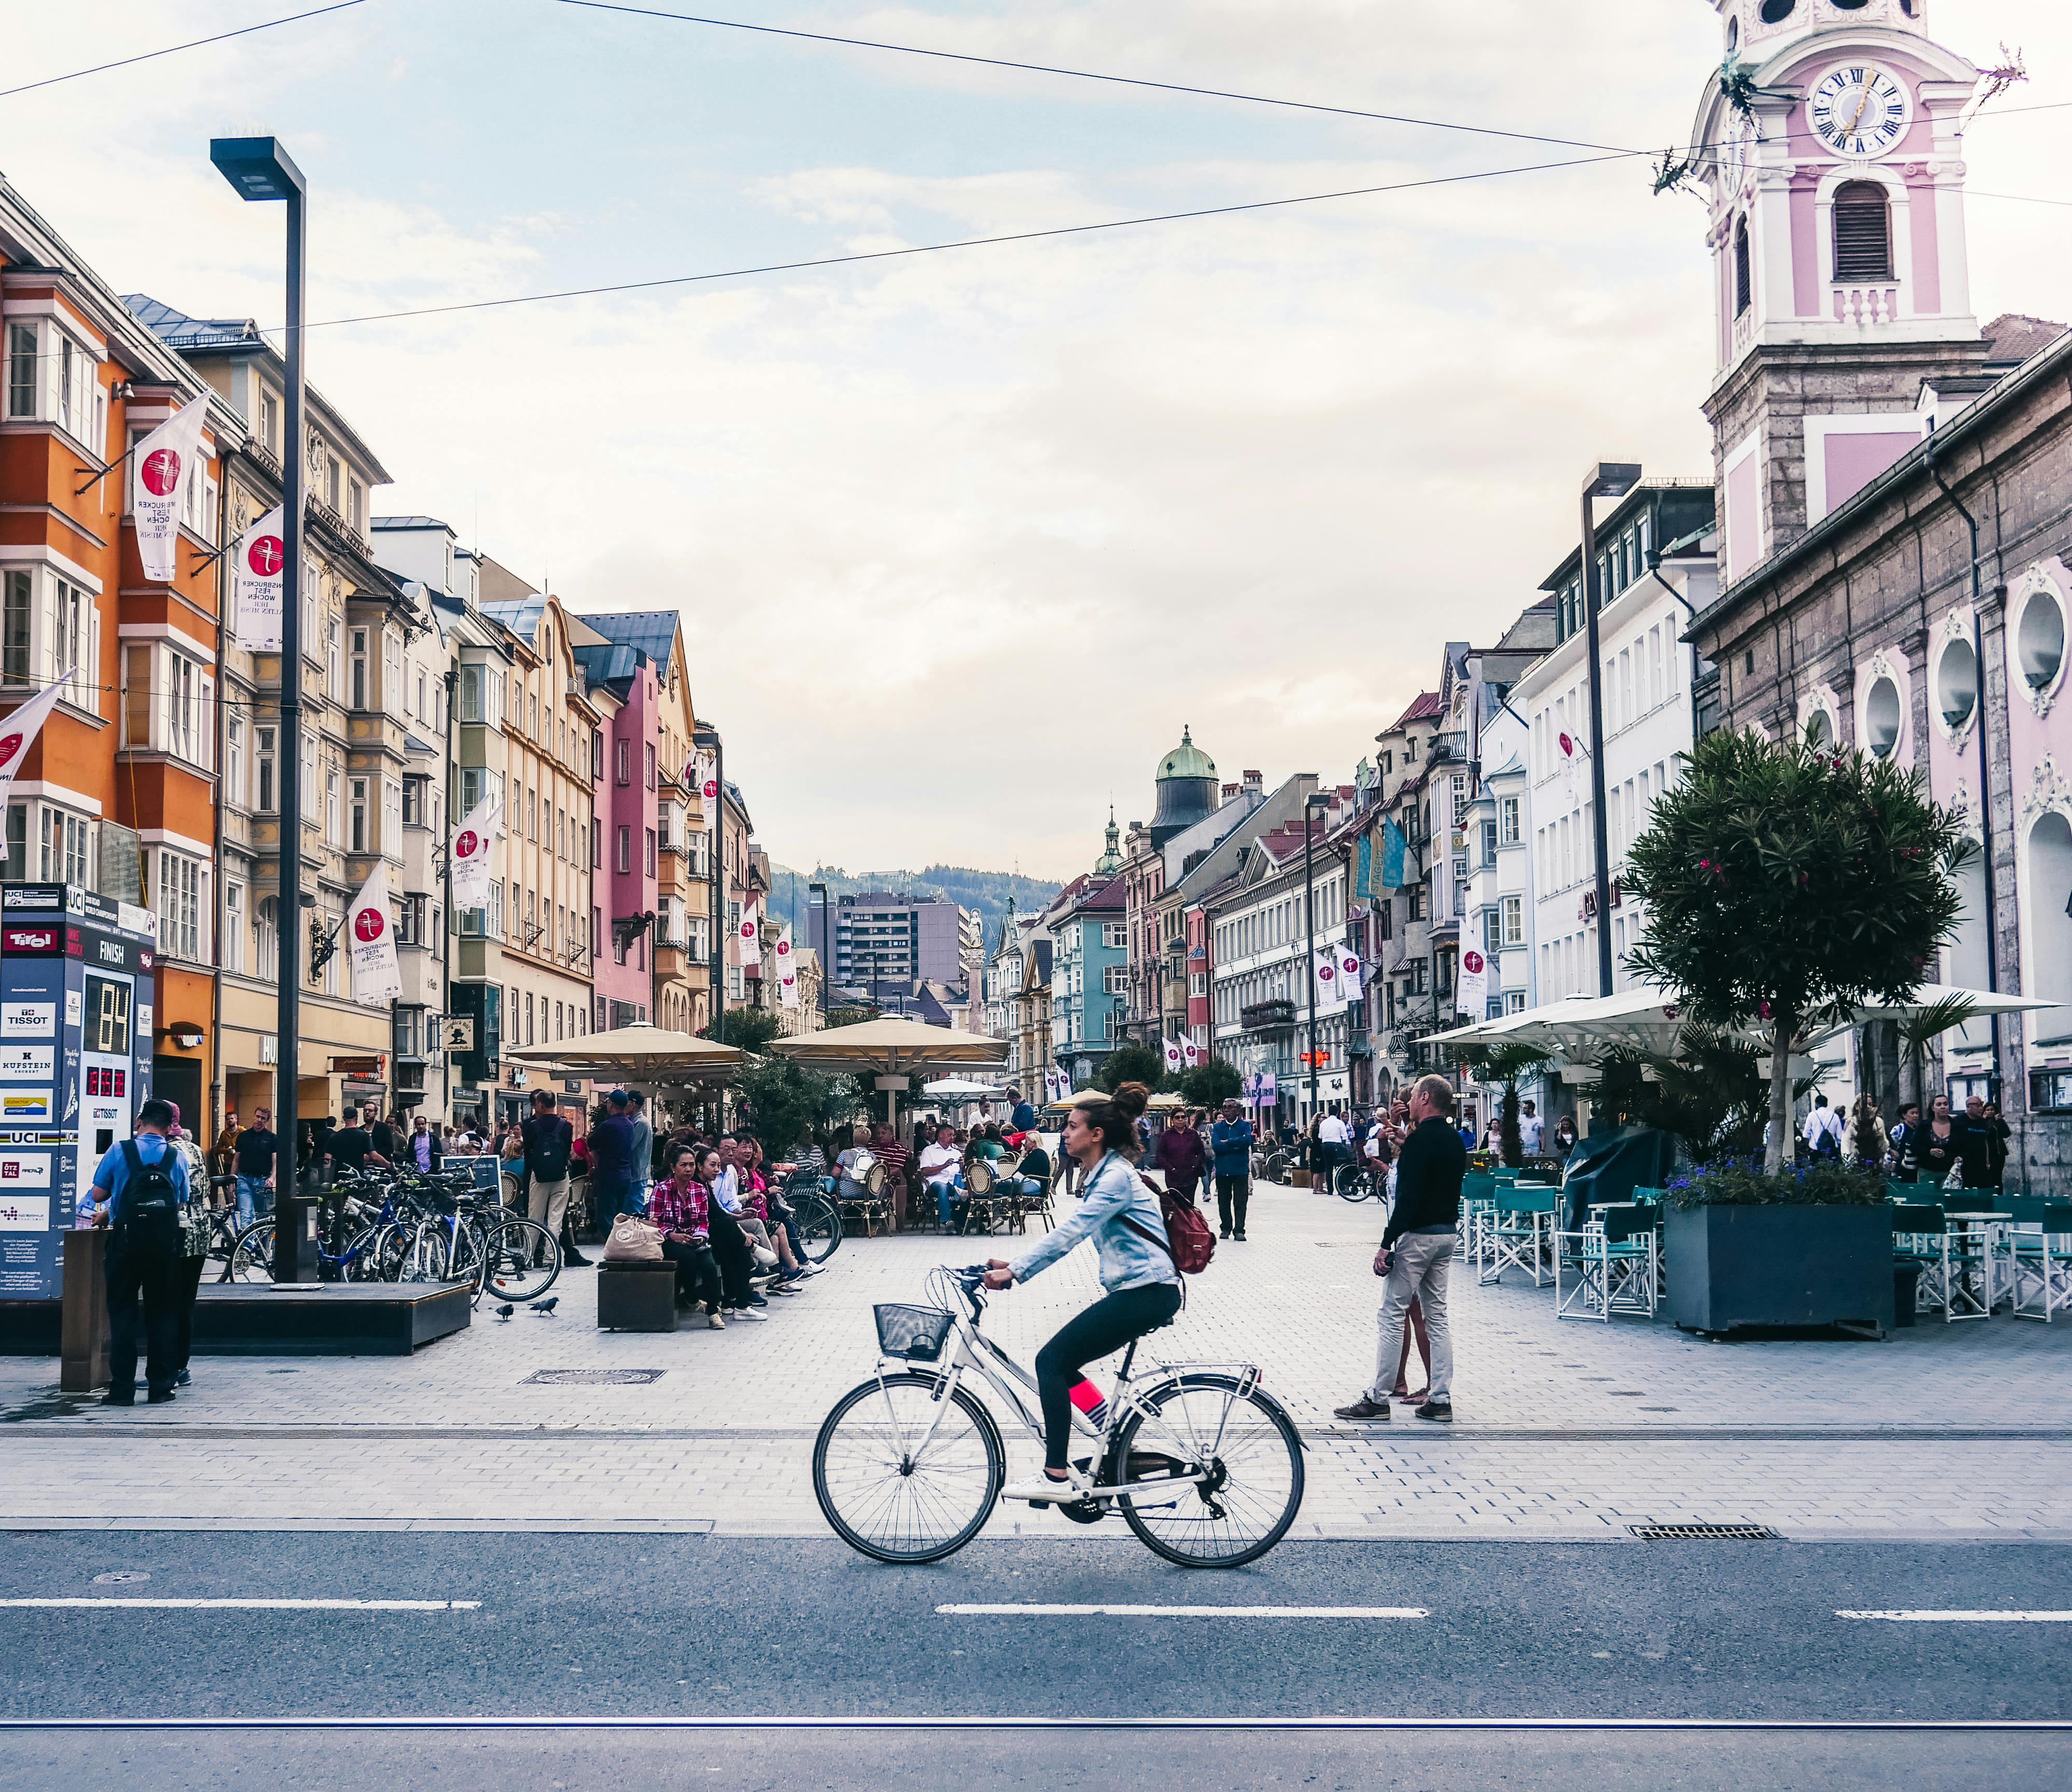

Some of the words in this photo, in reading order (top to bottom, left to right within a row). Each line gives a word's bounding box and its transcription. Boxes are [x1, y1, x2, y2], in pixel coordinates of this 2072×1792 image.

[70, 890, 83, 911] UCI
[10, 933, 51, 948] Tirol
[100, 940, 124, 964] FINISH
[101, 1108, 118, 1119] TISSOT
[12, 1132, 39, 1143] UCI
[4, 1163, 18, 1171] ÖTZ
